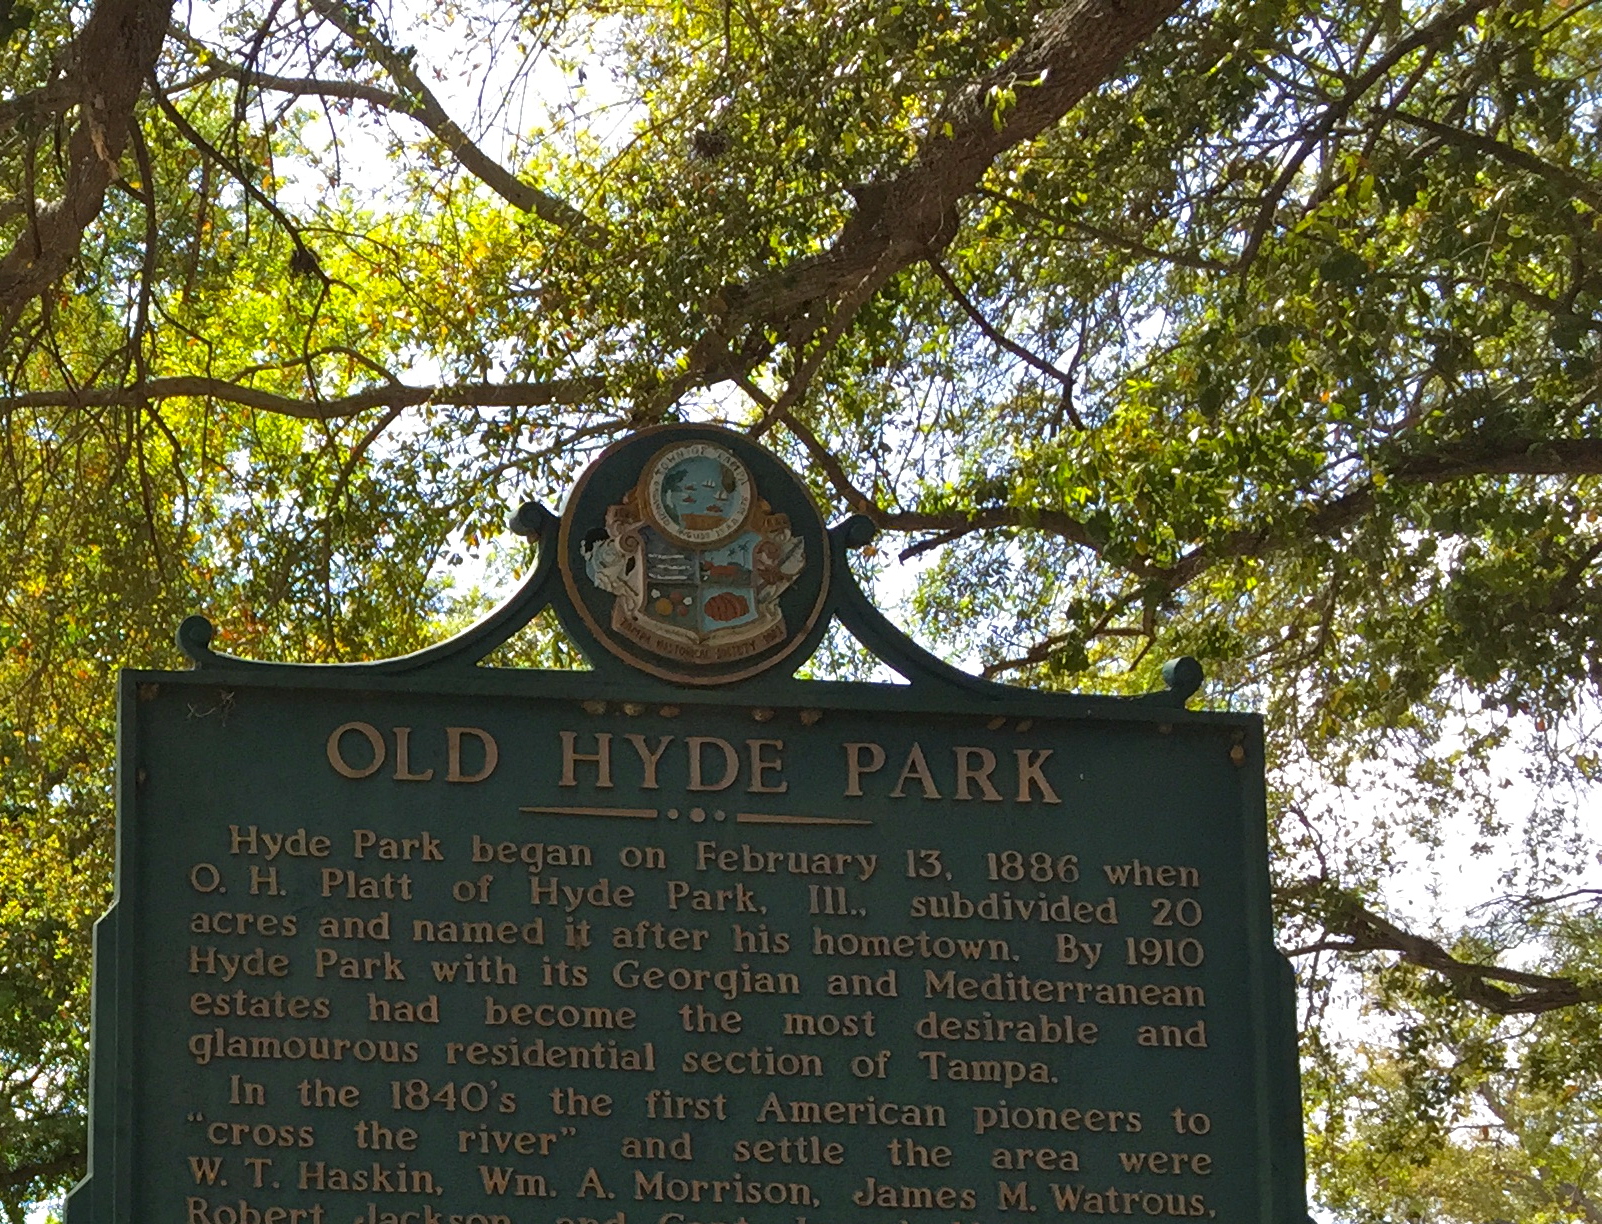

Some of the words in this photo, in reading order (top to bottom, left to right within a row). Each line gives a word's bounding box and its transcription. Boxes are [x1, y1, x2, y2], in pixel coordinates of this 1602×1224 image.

[326, 721, 498, 783] OLD
[560, 731, 787, 794] HYDE
[843, 742, 1062, 804] PARK
[230, 826, 331, 860] Hyde
[354, 829, 443, 862] Park
[473, 835, 592, 872] began
[620, 846, 666, 869] on
[696, 841, 877, 880] February
[906, 850, 953, 880] 13,
[988, 851, 1078, 883] 1886
[1104, 858, 1200, 888] when
[191, 864, 227, 893] O.
[250, 866, 287, 896] H.
[322, 868, 412, 901] Platt
[453, 875, 494, 902] of
[531, 877, 634, 911] Hyde
[669, 882, 767, 915] Park,
[911, 892, 1118, 924] subdivided
[1152, 898, 1202, 927] 20
[191, 912, 297, 937] acres
[319, 912, 389, 940] and
[413, 917, 544, 945] named
[566, 917, 590, 950] it
[612, 919, 709, 952] after
[735, 925, 789, 954] his
[814, 927, 1019, 962] hometown.
[1056, 934, 1101, 969] By
[1127, 938, 1204, 967] 1910
[190, 946, 289, 981] Hyde
[315, 949, 405, 981] Park
[432, 955, 518, 984] with
[542, 957, 587, 987] its
[614, 960, 800, 1000] Georgian
[828, 970, 897, 998] and
[925, 970, 1206, 1007] Mediterranean
[190, 989, 329, 1018] estates
[370, 994, 439, 1024] had
[486, 997, 636, 1029] become
[680, 1004, 741, 1035] the
[785, 1011, 876, 1038] most
[916, 1012, 1098, 1046] desirable
[1138, 1020, 1207, 1049] and
[189, 1029, 419, 1064] glamourous
[447, 1040, 655, 1073] residential
[683, 1048, 822, 1077] section
[850, 1050, 891, 1079] of
[918, 1052, 1060, 1085] Tampa.
[229, 1074, 264, 1106] In
[298, 1078, 359, 1109] the
[550, 1087, 612, 1117] the
[646, 1090, 726, 1121] first
[757, 1092, 946, 1128] American
[974, 1100, 1142, 1134] pioneers
[1171, 1106, 1211, 1135] to
[355, 1121, 418, 1151] the
[621, 1132, 693, 1161] and
[734, 1135, 844, 1165] settle
[888, 1138, 953, 1167] the
[992, 1148, 1080, 1172] area
[1120, 1151, 1212, 1175] were
[189, 1156, 228, 1188] W.
[245, 1157, 280, 1189] T.
[299, 1161, 445, 1195] Haskin,
[480, 1165, 557, 1197] Wm.
[577, 1168, 615, 1200] A.
[634, 1170, 820, 1208] Morrison,
[852, 1178, 976, 1211] James
[998, 1181, 1036, 1212] M.
[1050, 1185, 1216, 1219] Watrous,
